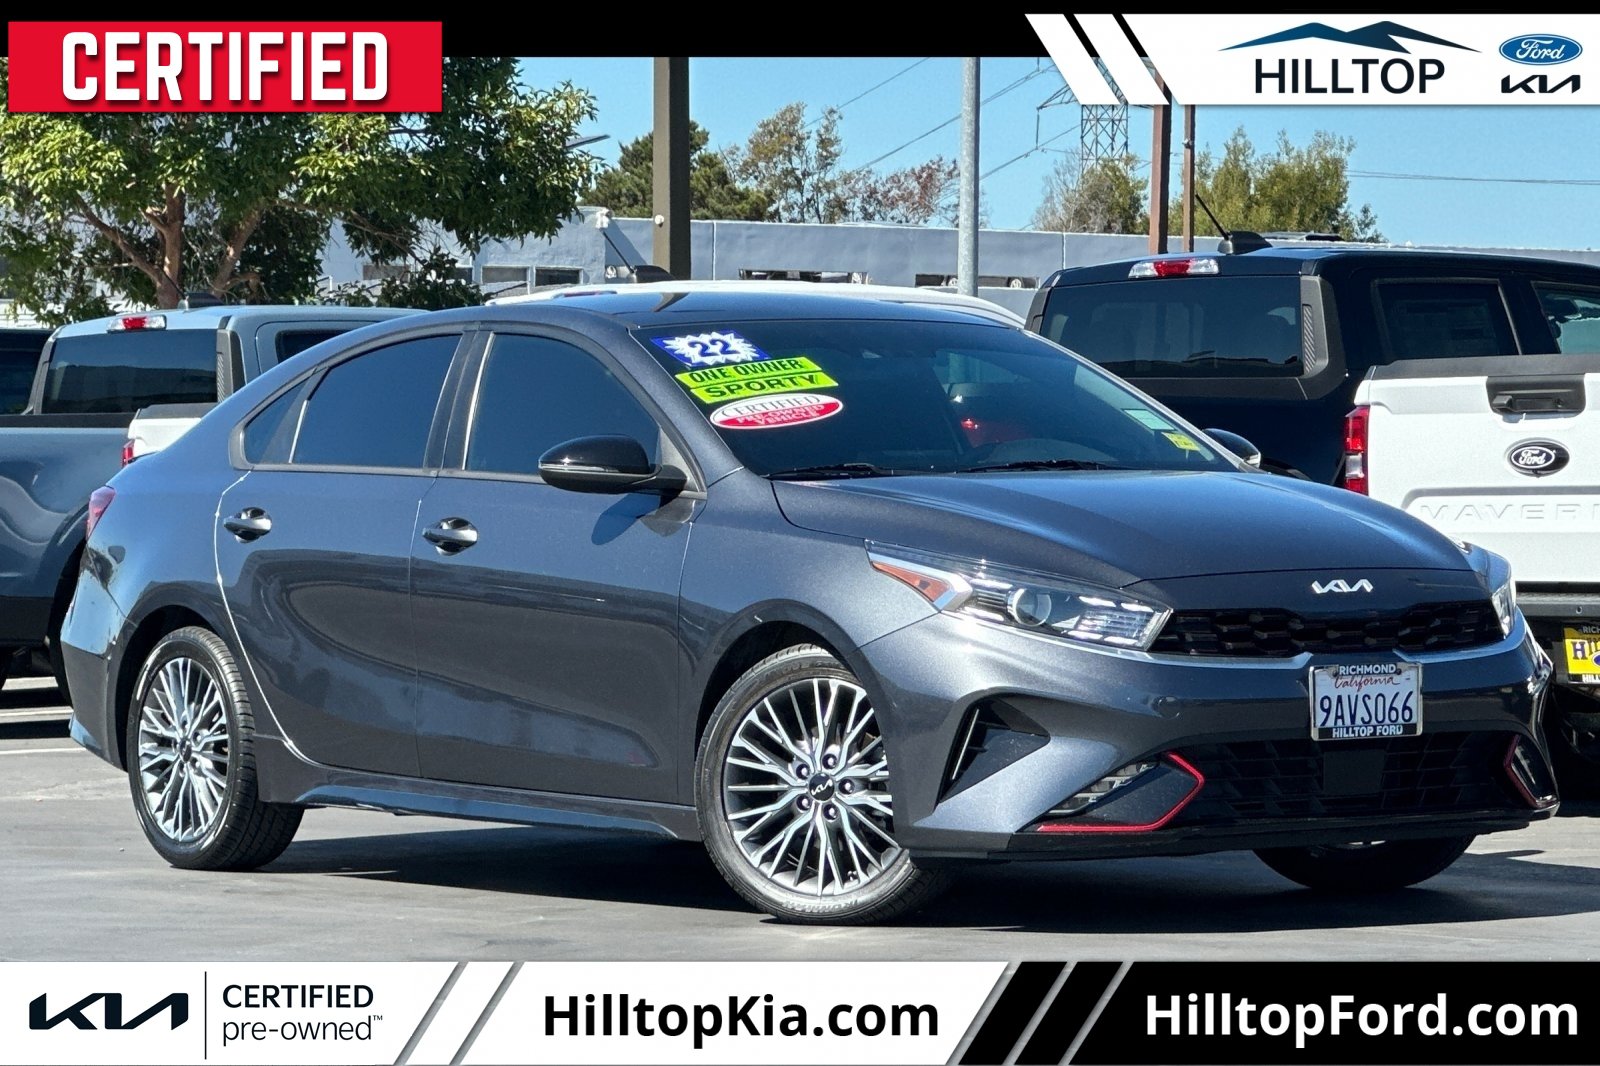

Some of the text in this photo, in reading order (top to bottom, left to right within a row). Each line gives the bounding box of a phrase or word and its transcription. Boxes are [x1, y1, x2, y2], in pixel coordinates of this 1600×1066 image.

[688, 339, 737, 358] 22
[689, 360, 805, 383] ONE OWNER
[705, 374, 817, 398] SPORTY
[721, 395, 821, 417] CERTIFIED
[1518, 449, 1547, 465] Ford
[1339, 663, 1397, 676] RICHMOND
[1334, 674, 1400, 693] California
[1319, 690, 1414, 727] 9AVS066
[1332, 725, 1403, 738] HILLTOP FORD
